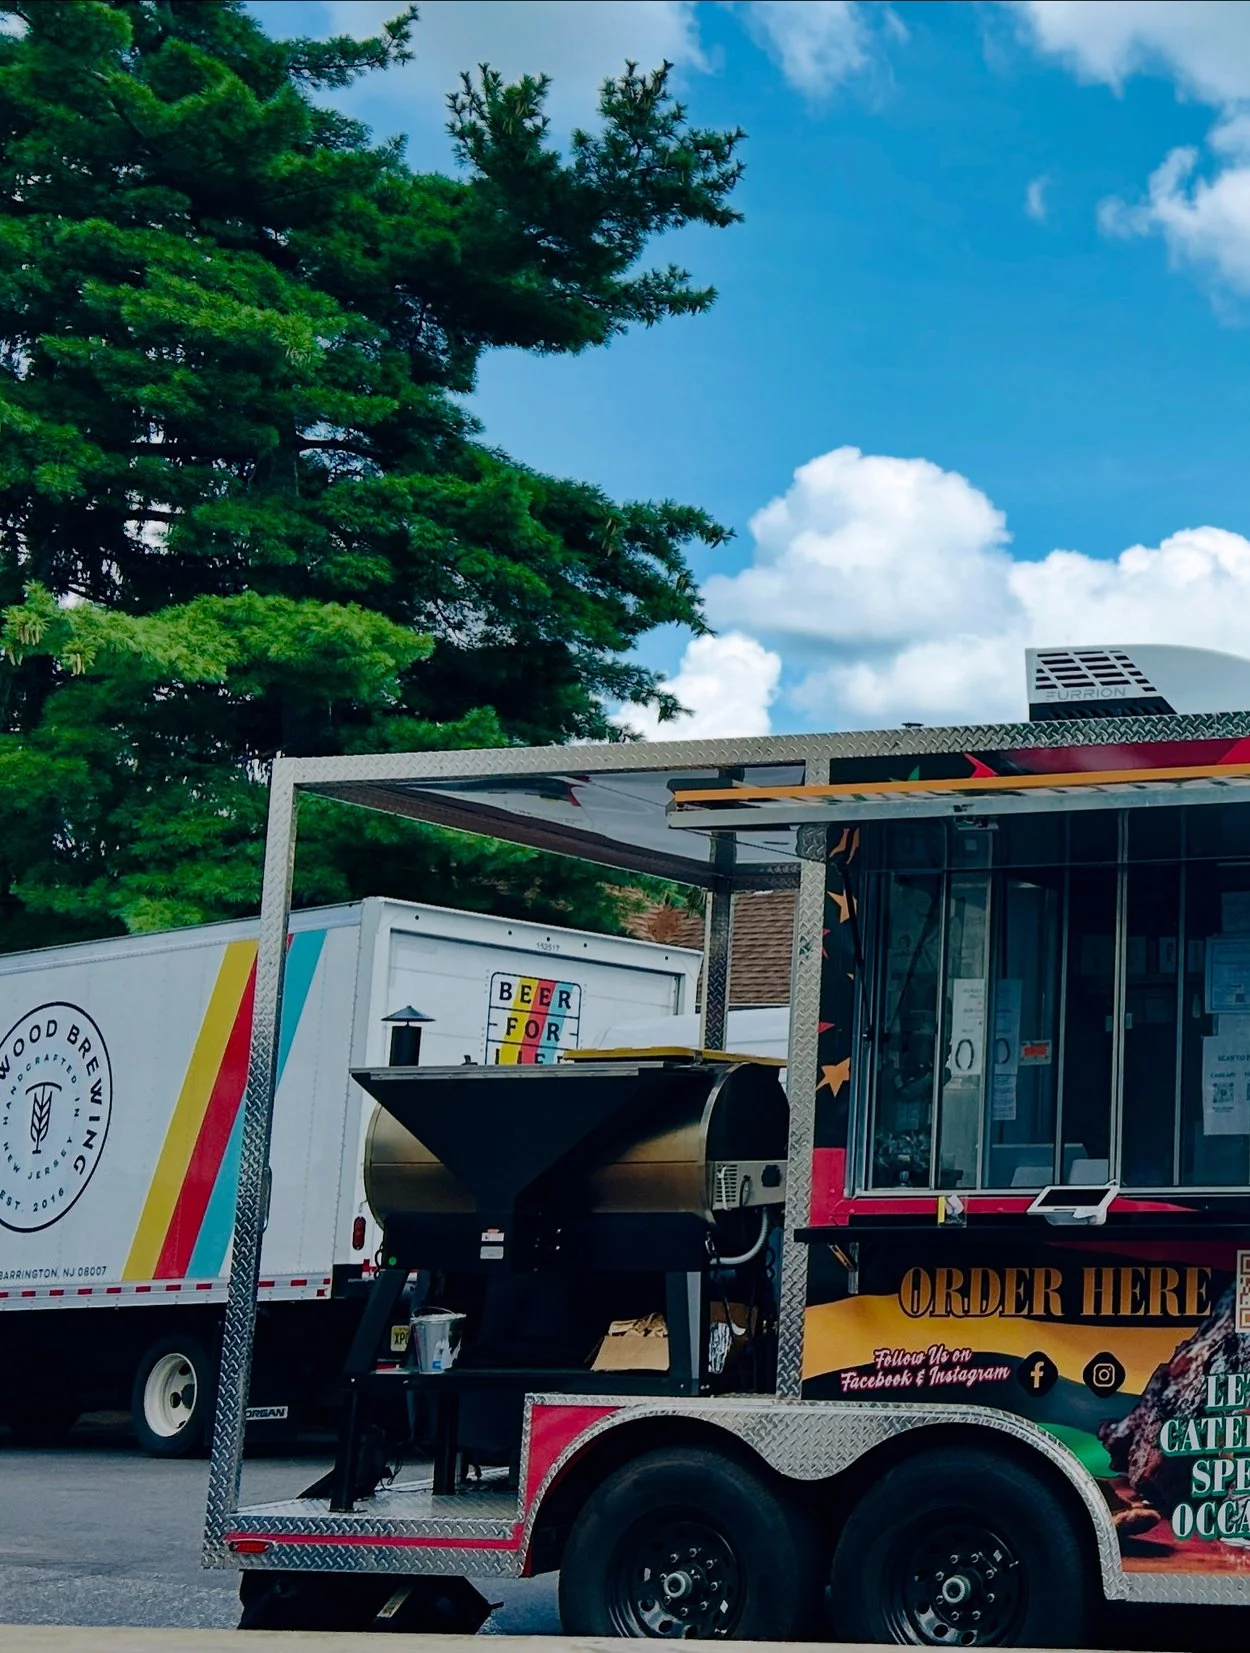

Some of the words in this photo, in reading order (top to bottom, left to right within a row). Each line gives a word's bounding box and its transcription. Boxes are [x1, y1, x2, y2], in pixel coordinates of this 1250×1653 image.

[1045, 687, 1127, 701] FURRION
[499, 981, 571, 1009] BEER
[506, 1017, 560, 1042] FOR
[3, 1053, 78, 1126] HANDCRAFTED
[74, 1097, 81, 1118] IN
[67, 1024, 103, 1175] BREWING
[4, 1141, 21, 1174] NEW
[27, 1136, 73, 1180] JERSEY
[33, 1187, 64, 1212] 2016
[63, 1267, 75, 1277] NJ
[78, 1265, 107, 1277] 08007
[899, 1265, 1065, 1318] ORDER
[1079, 1265, 1213, 1317] HERE
[874, 1348, 925, 1369] Follow
[928, 1344, 949, 1366] Us
[951, 1347, 973, 1364] on
[840, 1370, 913, 1392] Facebook
[915, 1369, 925, 1387] &
[928, 1364, 1011, 1388] Instagram
[245, 1408, 286, 1418] ORGAN
